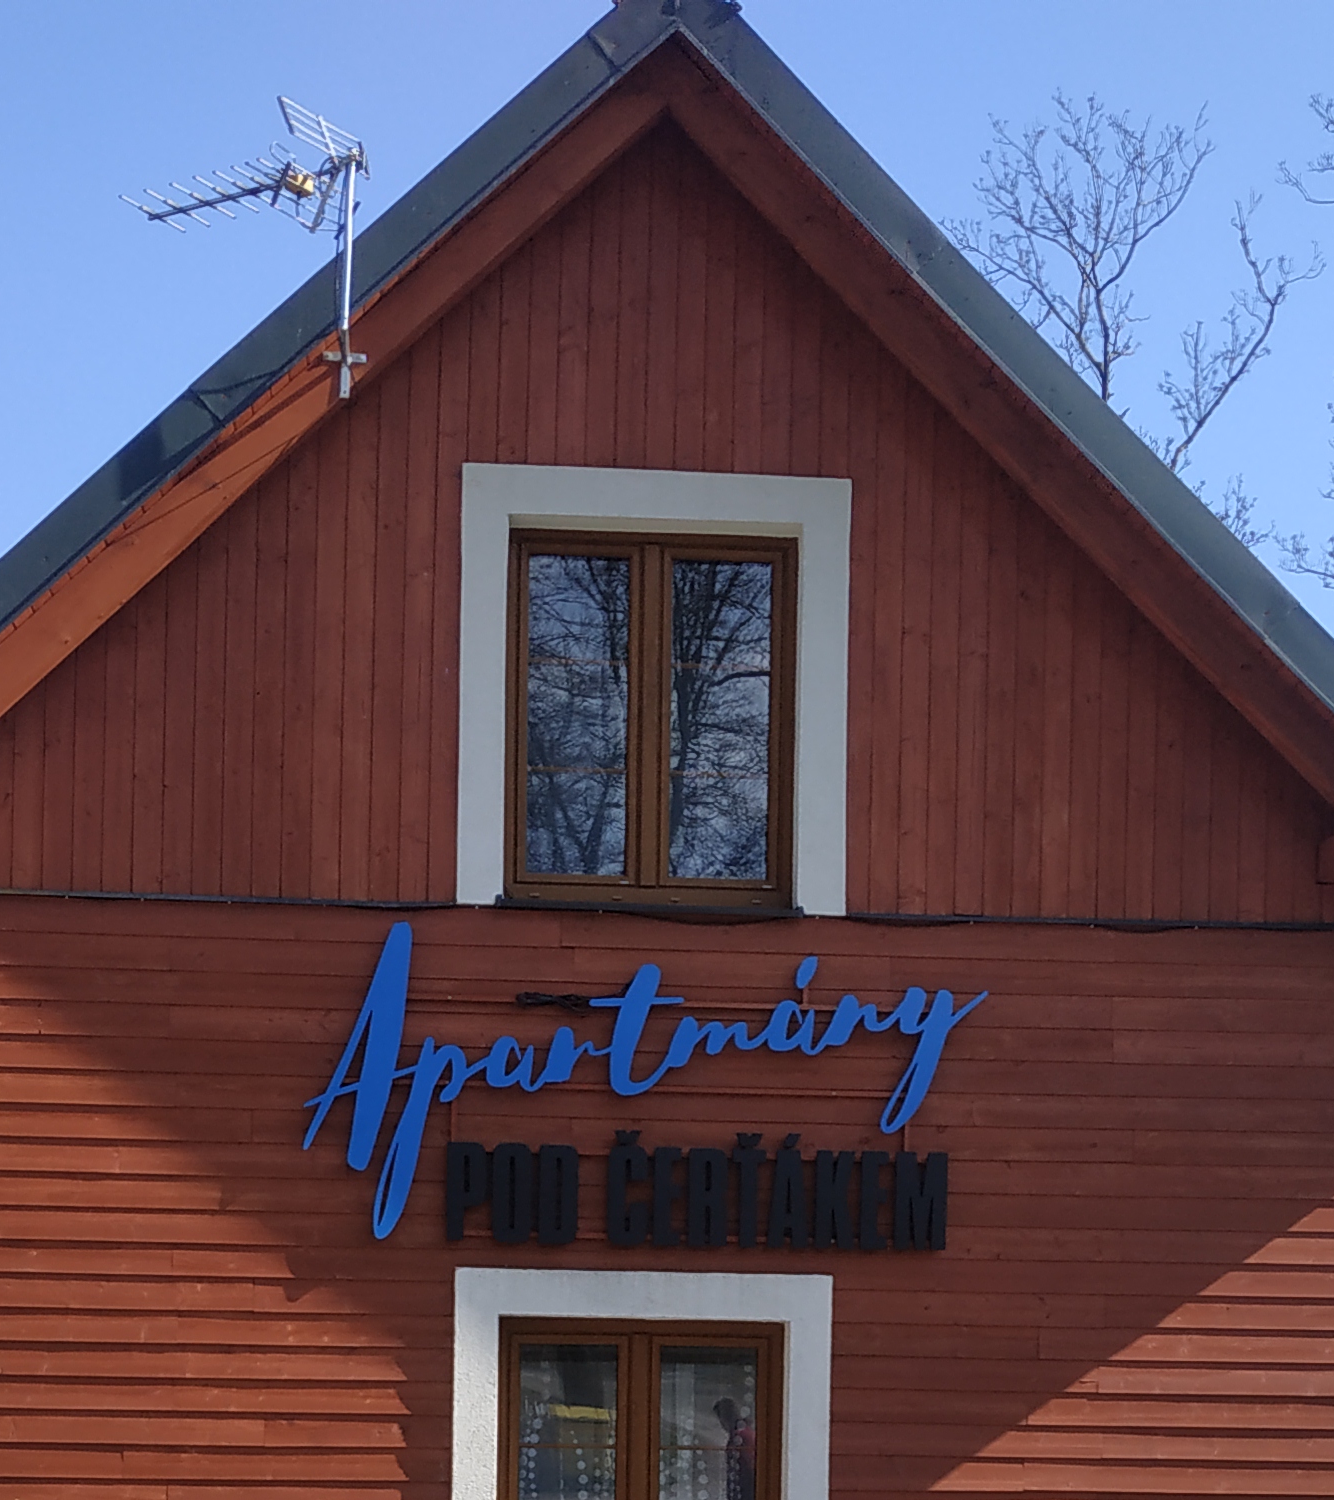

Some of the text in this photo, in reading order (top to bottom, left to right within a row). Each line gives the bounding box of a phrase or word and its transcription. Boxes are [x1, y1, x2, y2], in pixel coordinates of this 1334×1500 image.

[303, 921, 989, 1240] Apartmány
[446, 1130, 949, 1252] POD ČERŤÁKEM
